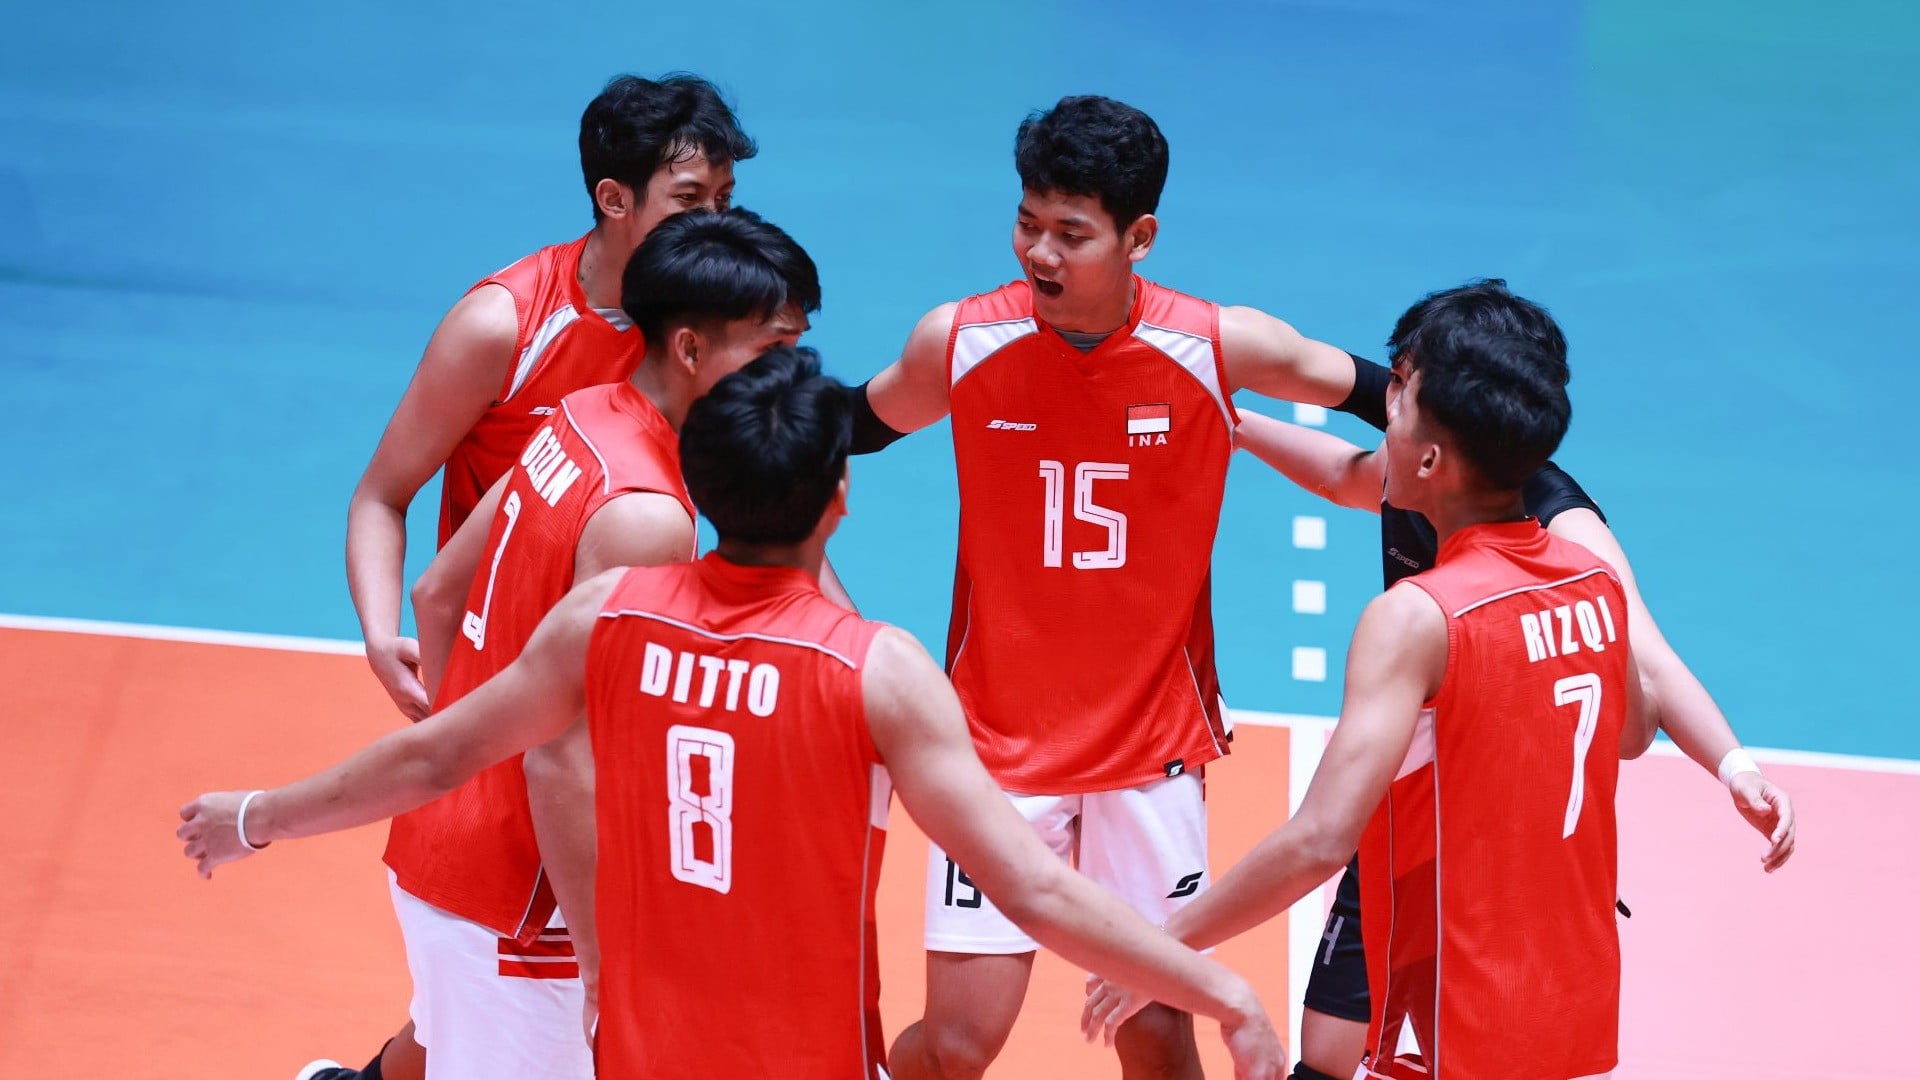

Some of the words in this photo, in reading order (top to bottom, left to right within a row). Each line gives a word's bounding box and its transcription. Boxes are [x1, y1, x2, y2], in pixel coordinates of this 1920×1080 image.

[1129, 433, 1168, 448] INA
[1039, 459, 1130, 570] 15
[1519, 595, 1616, 663] RIZQI
[640, 641, 780, 717] DITTO
[1554, 672, 1602, 840] 7
[667, 724, 735, 895] 8
